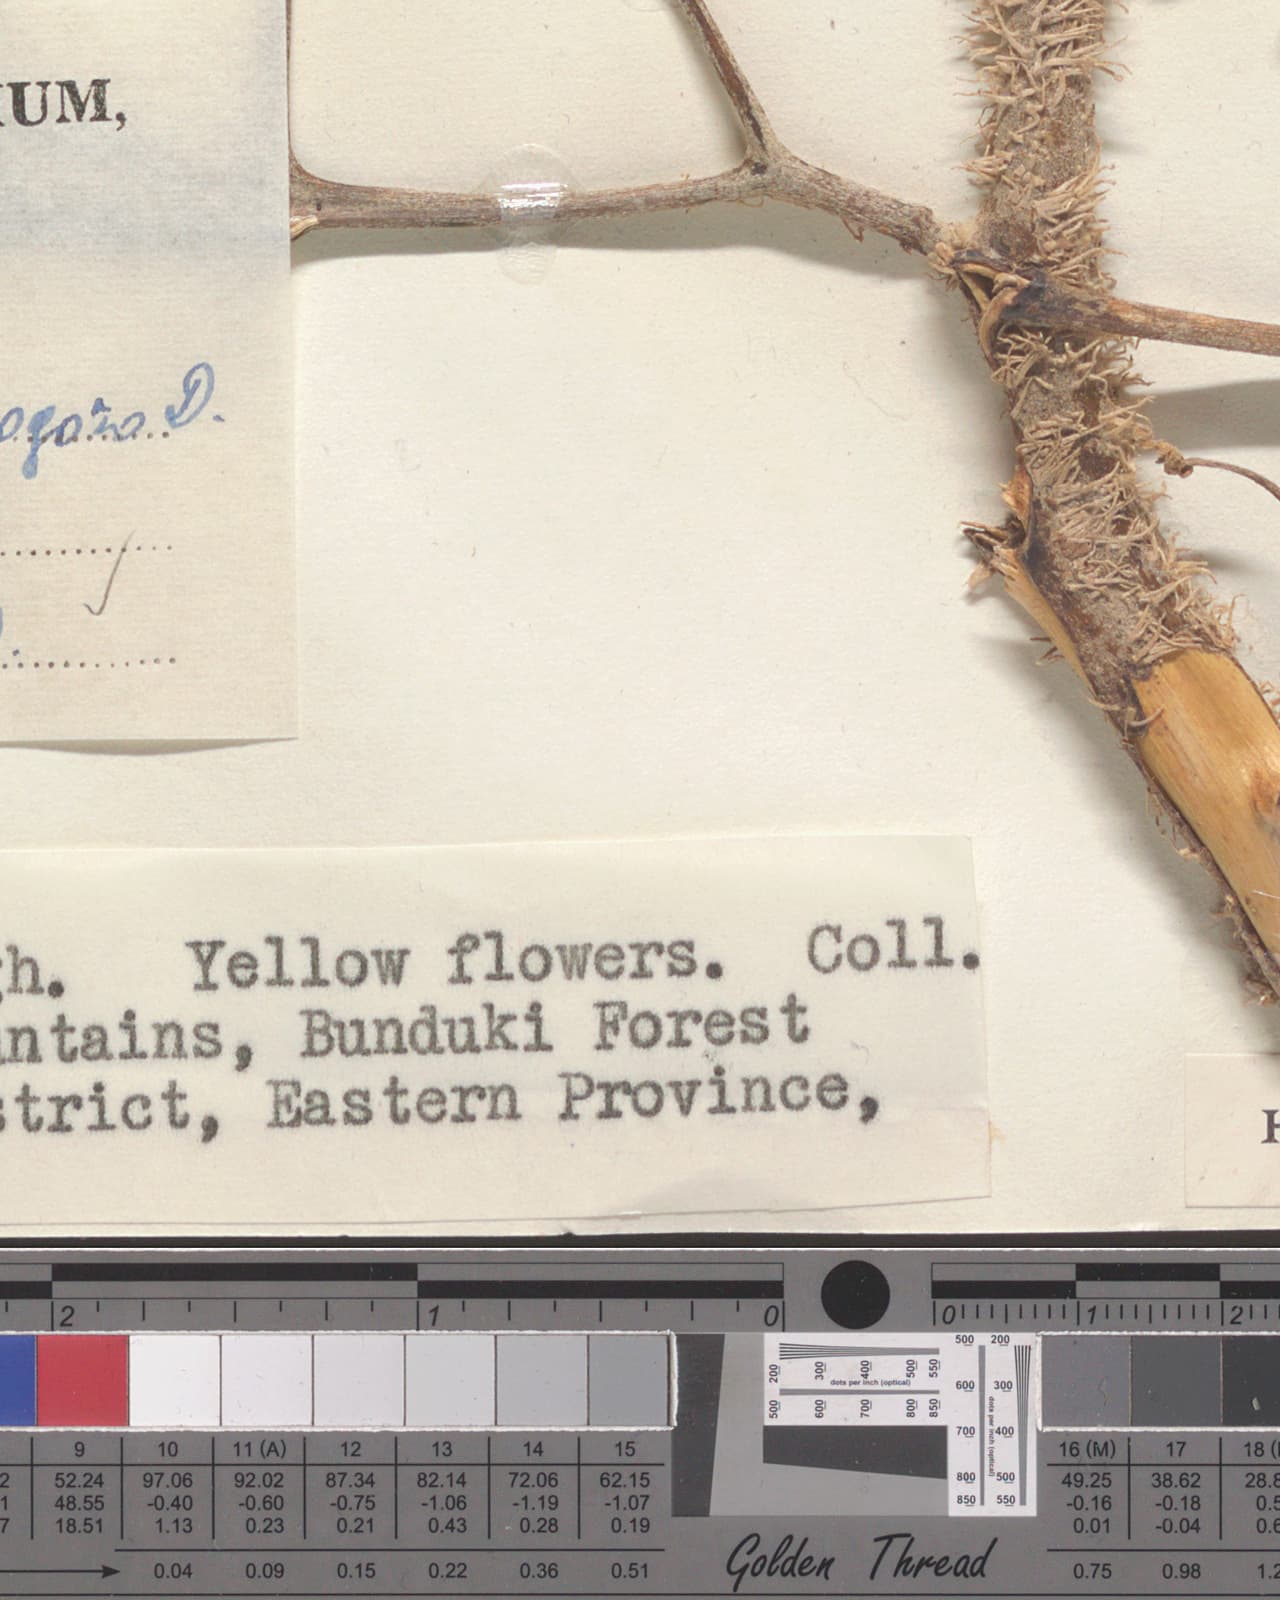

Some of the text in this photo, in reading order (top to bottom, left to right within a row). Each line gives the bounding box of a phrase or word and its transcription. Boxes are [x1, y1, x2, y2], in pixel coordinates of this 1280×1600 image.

[185, 936, 410, 991] Yellow
[448, 930, 723, 984] flowers.
[808, 917, 980, 974] Coll.
[300, 1001, 553, 1058] Bunduki
[593, 993, 810, 1051] Forest
[267, 1076, 522, 1128] Eastern
[558, 1065, 879, 1124] Province,
[61, 1306, 75, 1327] 2
[427, 1306, 440, 1326] 1
[764, 1305, 779, 1327] 0
[942, 1305, 956, 1325] 0
[1086, 1306, 1097, 1325] 1
[1230, 1305, 1244, 1325] 2
[881, 1379, 911, 1387] (optical)
[55, 1473, 104, 1488] 52.24
[143, 1472, 193, 1488] 97.06
[235, 1472, 283, 1488] 92.02
[326, 1472, 375, 1488] 87.34
[417, 1472, 466, 1488] 82.14
[509, 1472, 558, 1488] 72.06
[600, 1472, 650, 1488] 62.15
[1062, 1472, 1112, 1488] 49.25
[1152, 1472, 1200, 1488] 38.62
[725, 1533, 998, 1592] Golden Thread
